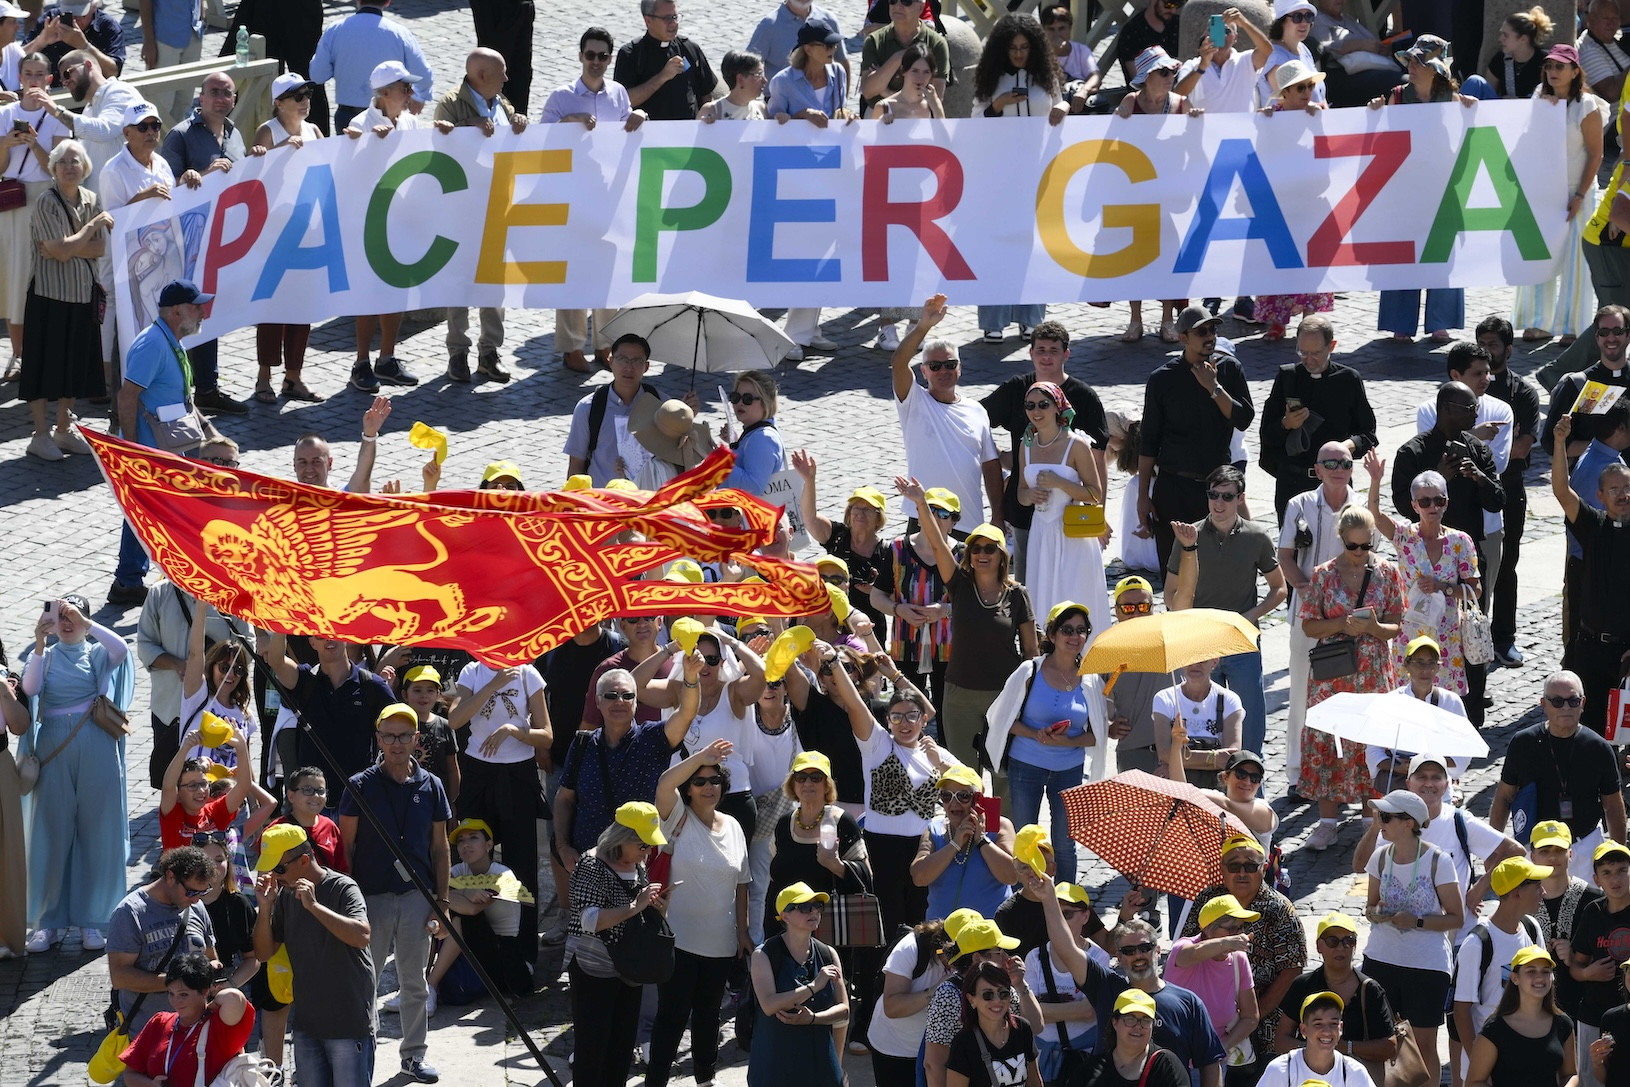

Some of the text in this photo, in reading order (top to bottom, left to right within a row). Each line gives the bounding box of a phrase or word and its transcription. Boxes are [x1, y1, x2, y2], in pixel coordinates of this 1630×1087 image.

[202, 125, 1553, 319] PACE PER GAZA
[760, 478, 792, 496] OMA
